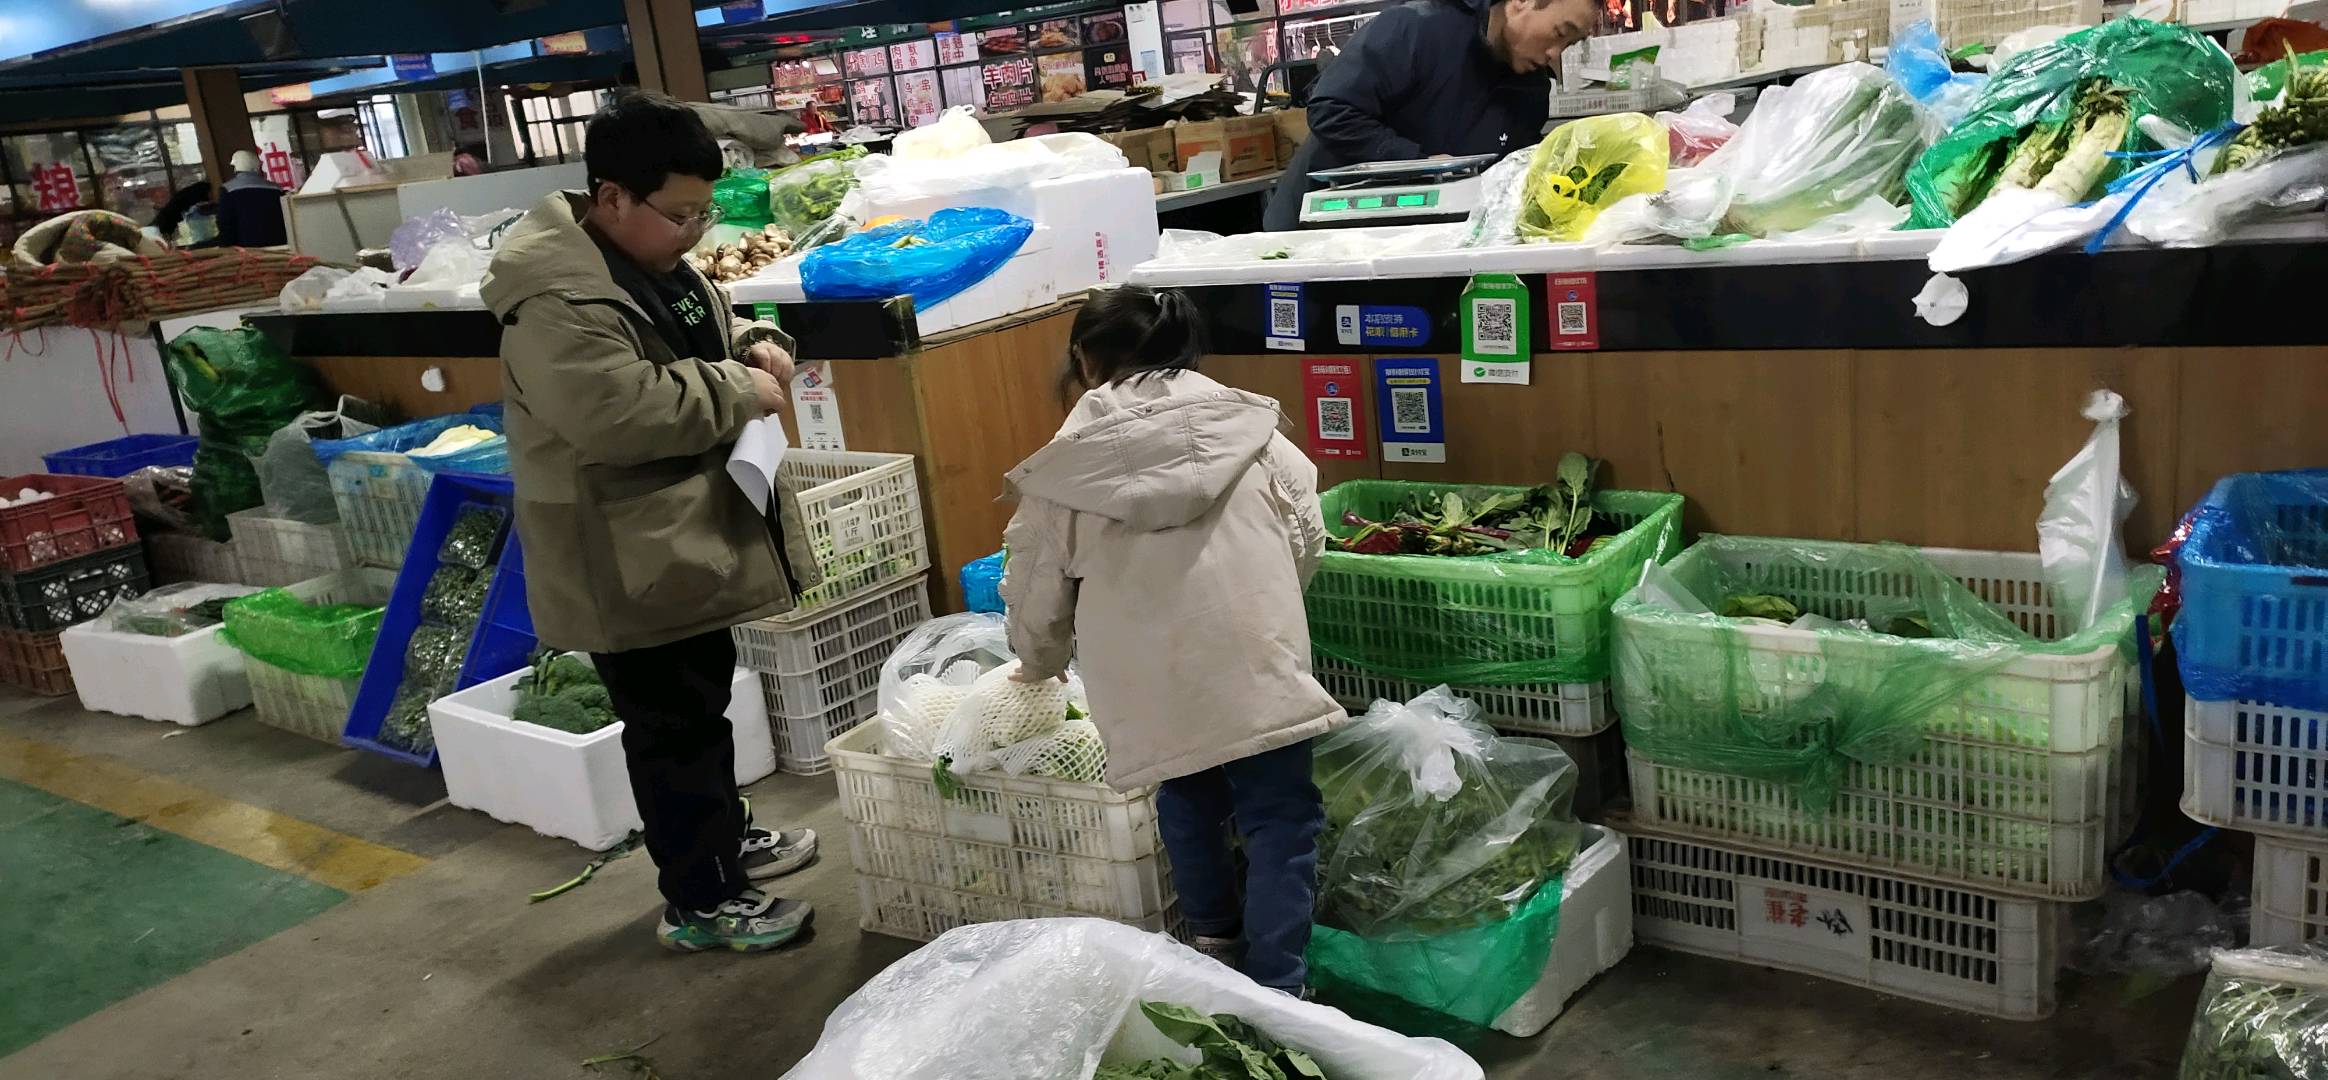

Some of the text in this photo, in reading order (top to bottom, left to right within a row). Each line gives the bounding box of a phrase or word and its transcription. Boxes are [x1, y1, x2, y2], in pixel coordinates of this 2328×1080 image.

[984, 58, 1034, 89] 羊肉片
[33, 162, 81, 210] 粮
